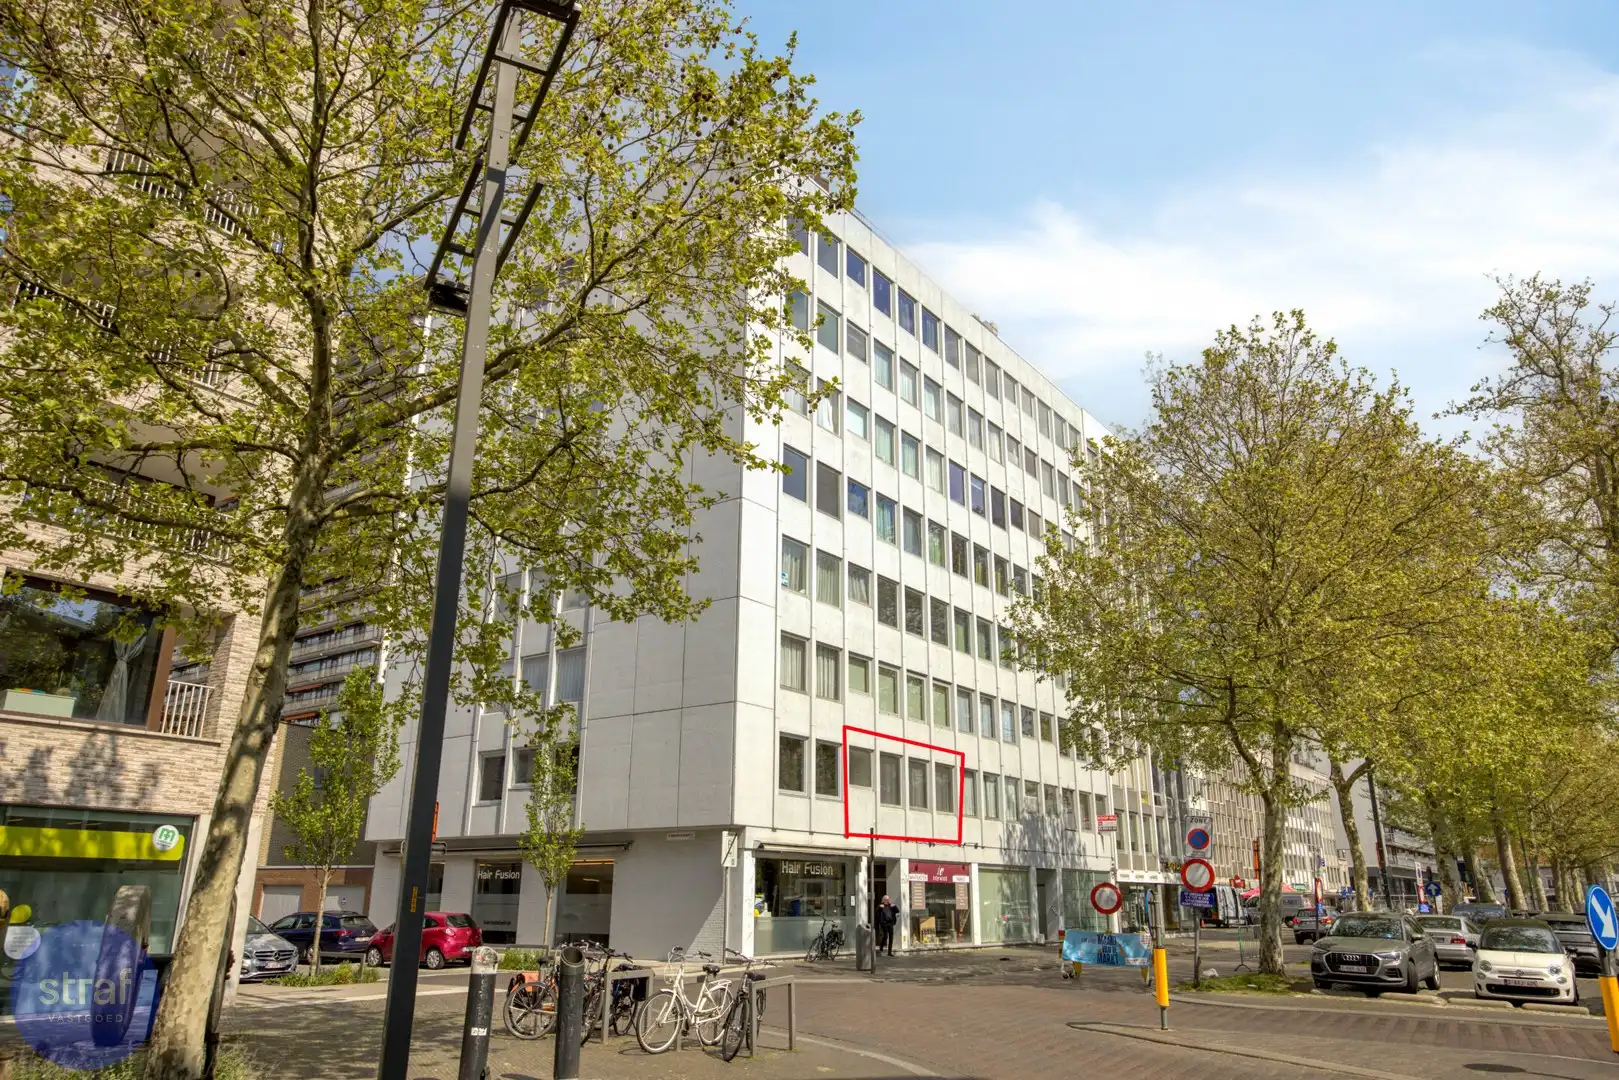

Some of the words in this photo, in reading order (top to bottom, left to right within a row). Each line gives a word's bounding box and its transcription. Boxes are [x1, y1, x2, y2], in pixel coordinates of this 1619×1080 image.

[781, 861, 800, 874] Hair
[804, 862, 833, 875] Fusion
[477, 870, 493, 880] Hair
[495, 869, 520, 880] Fusion
[1097, 953, 1119, 965] MARKT
